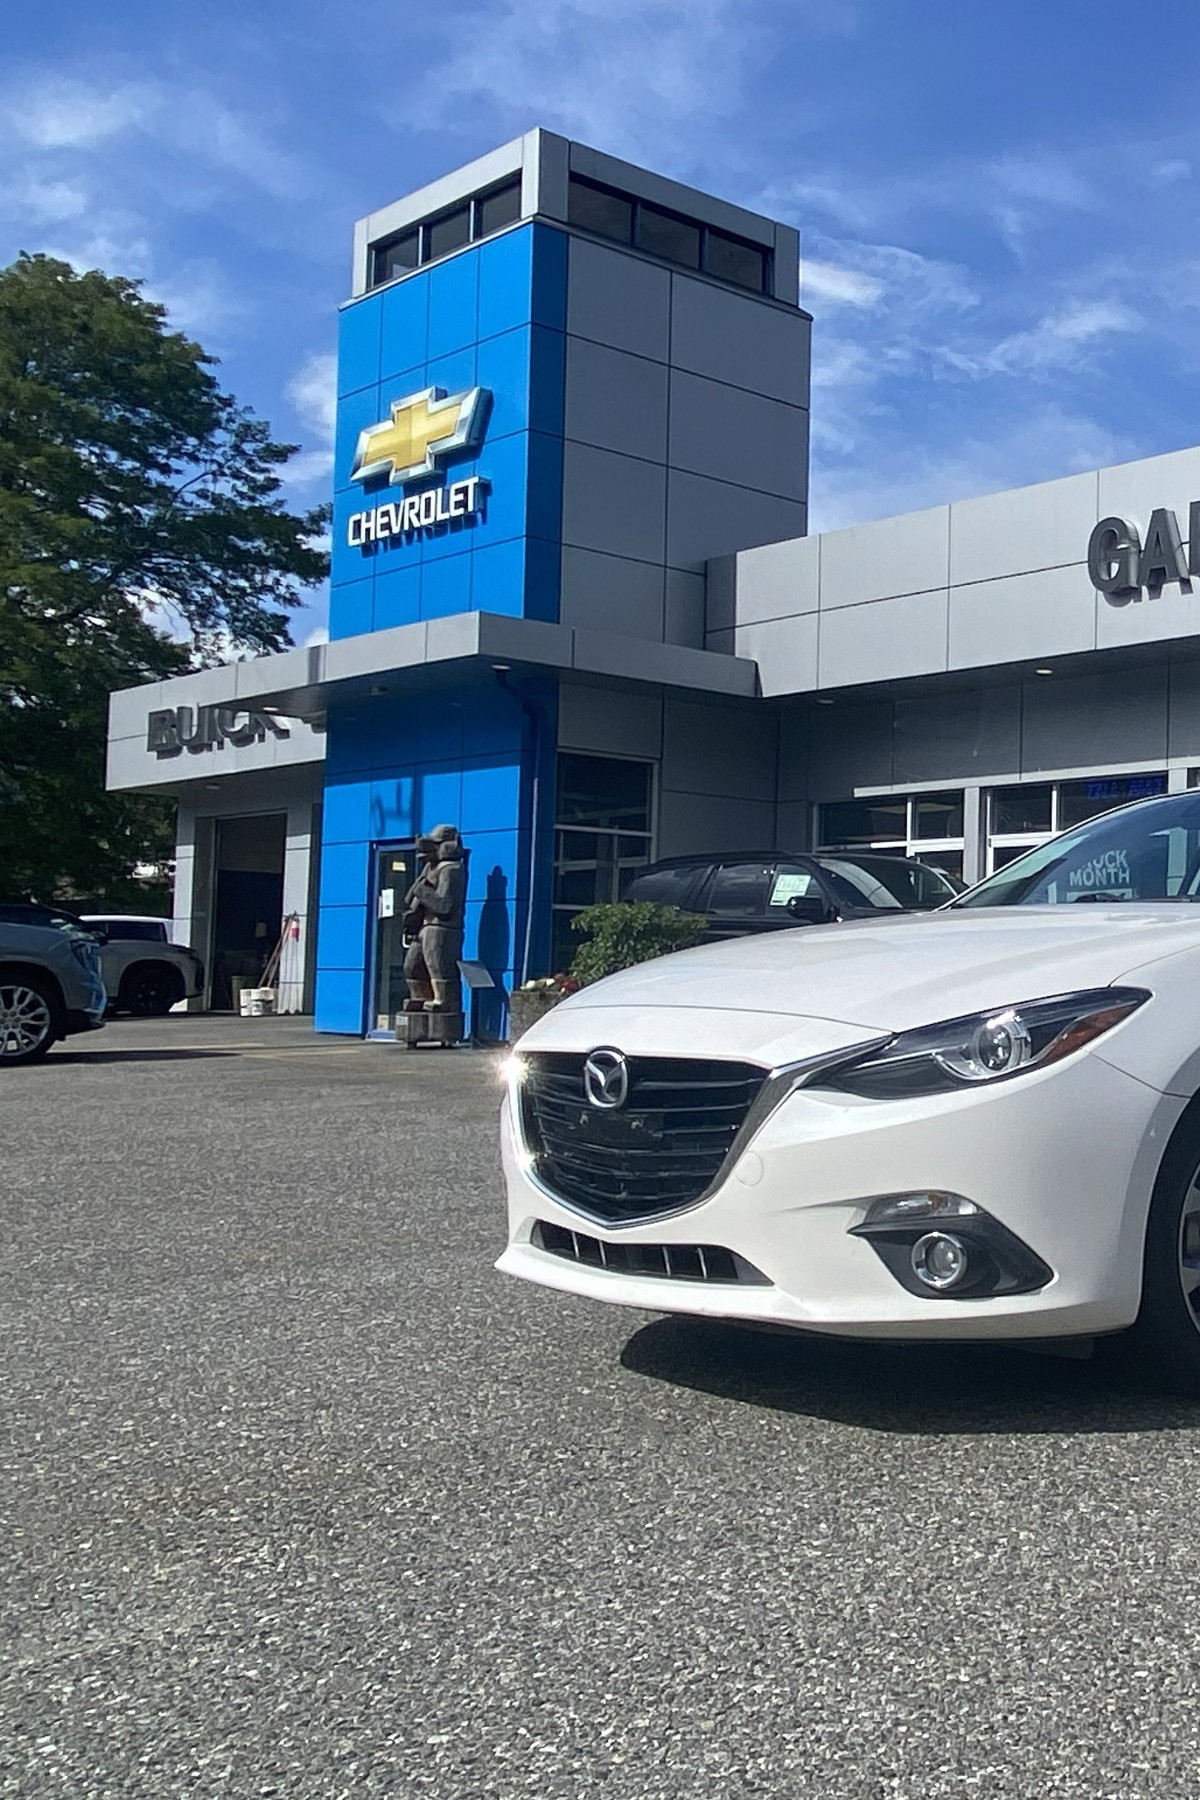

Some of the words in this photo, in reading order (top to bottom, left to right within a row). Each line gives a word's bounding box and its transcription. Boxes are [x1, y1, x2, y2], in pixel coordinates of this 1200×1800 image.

[348, 476, 480, 546] CHEVROLET
[1082, 850, 1128, 869] UCK
[1070, 868, 1130, 887] MONTH
